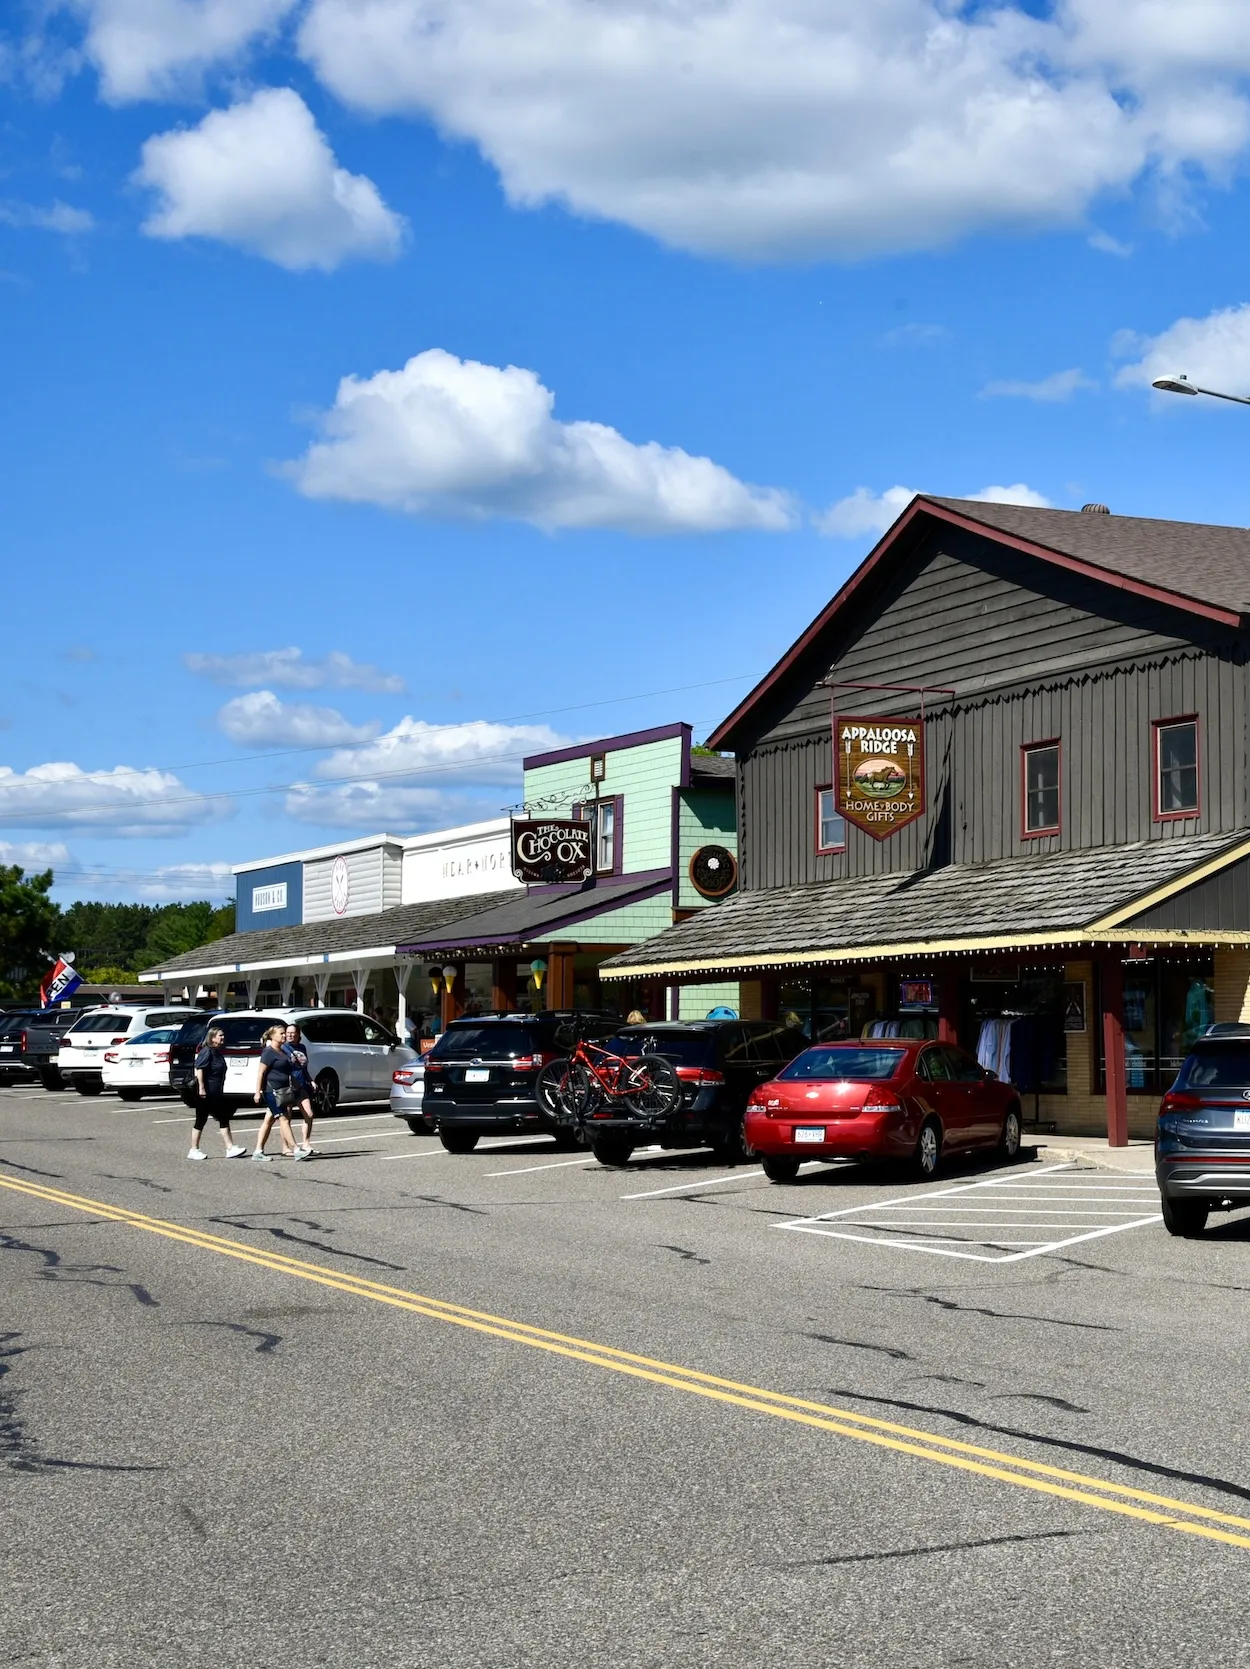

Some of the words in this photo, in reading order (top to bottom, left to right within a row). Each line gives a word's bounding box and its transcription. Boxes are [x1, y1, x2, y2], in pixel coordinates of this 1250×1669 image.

[841, 726, 917, 743] APPALOOSA
[860, 740, 898, 755] RIDGE
[845, 800, 880, 812] HOME
[886, 802, 915, 813] BODY
[866, 811, 895, 823] GIFTS
[537, 824, 556, 836] THE
[517, 829, 589, 864] CHOCOLATE
[557, 842, 587, 864] OX
[481, 851, 512, 872] NOR
[46, 973, 70, 998] PEN
